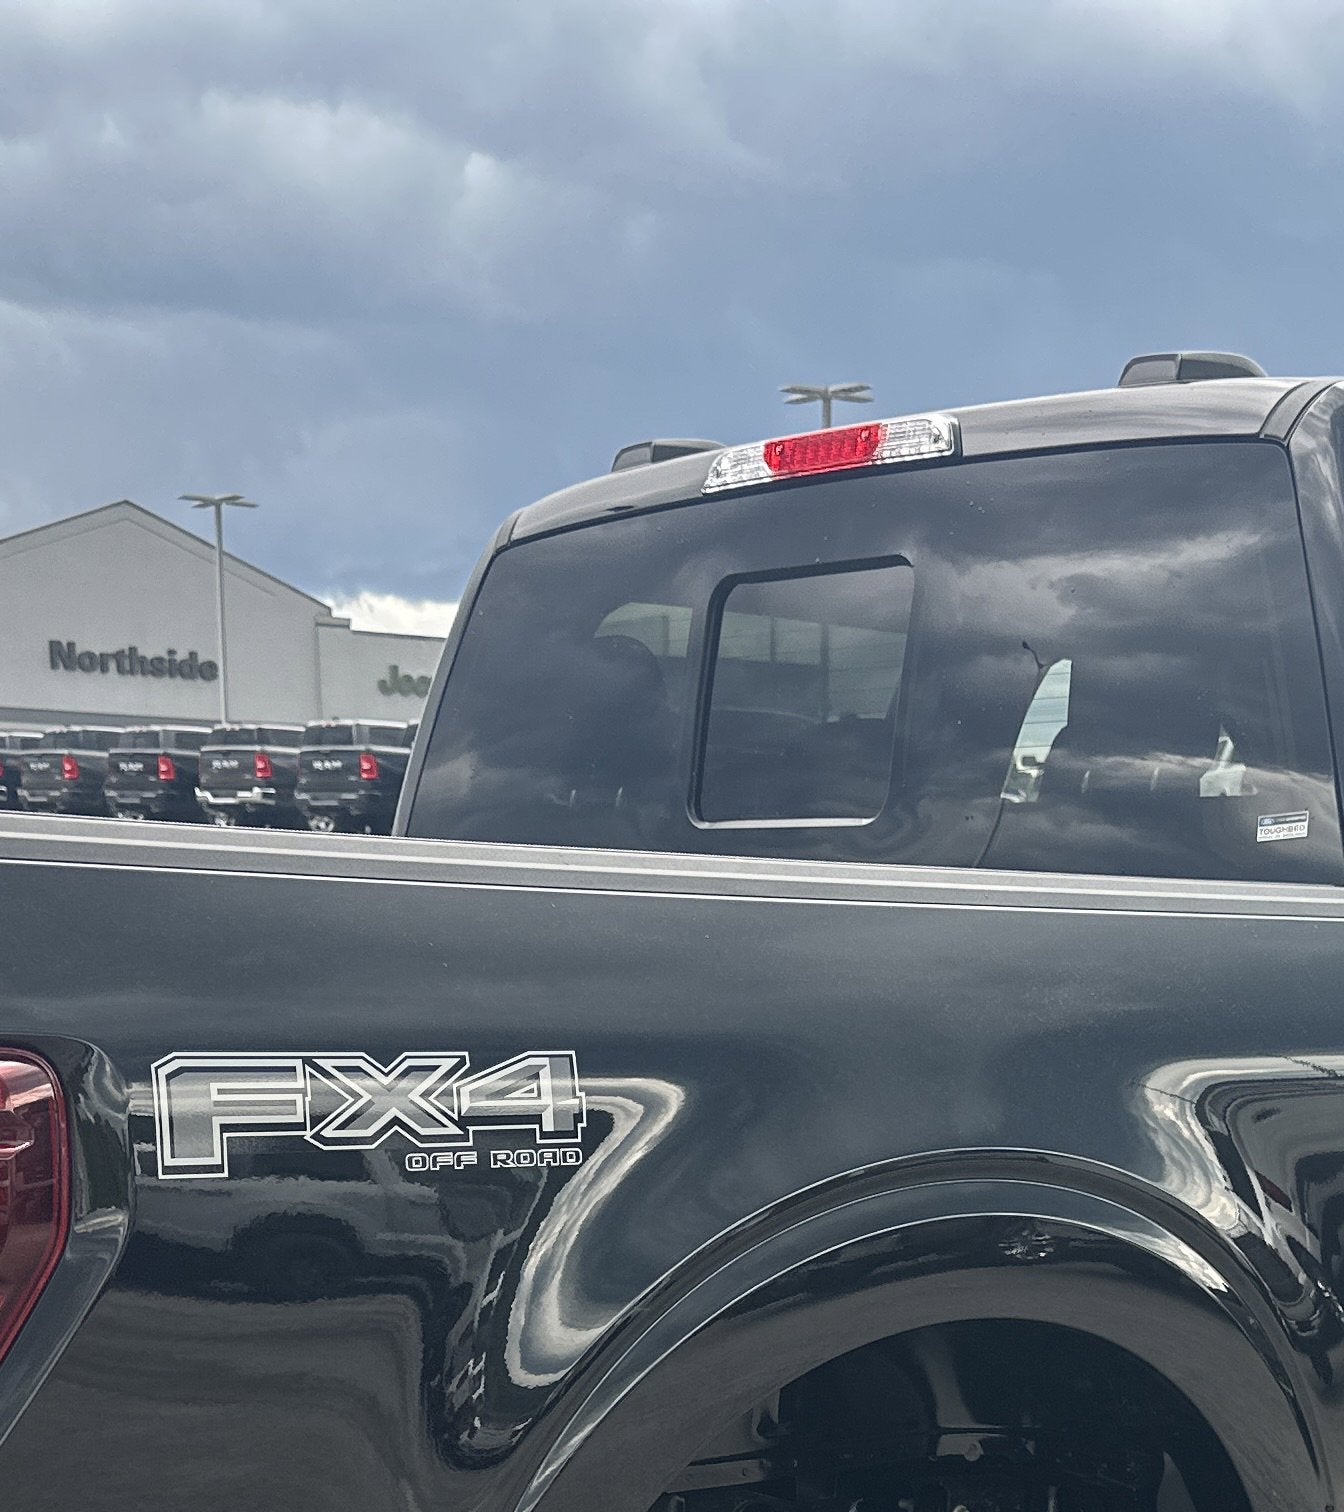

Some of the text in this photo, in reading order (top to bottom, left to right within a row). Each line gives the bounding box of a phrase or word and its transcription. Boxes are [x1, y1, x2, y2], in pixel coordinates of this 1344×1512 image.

[48, 639, 219, 682] Northside
[377, 664, 431, 699] Jee
[150, 1050, 587, 1179] FX4
[405, 1148, 583, 1172] OFF ROAD
